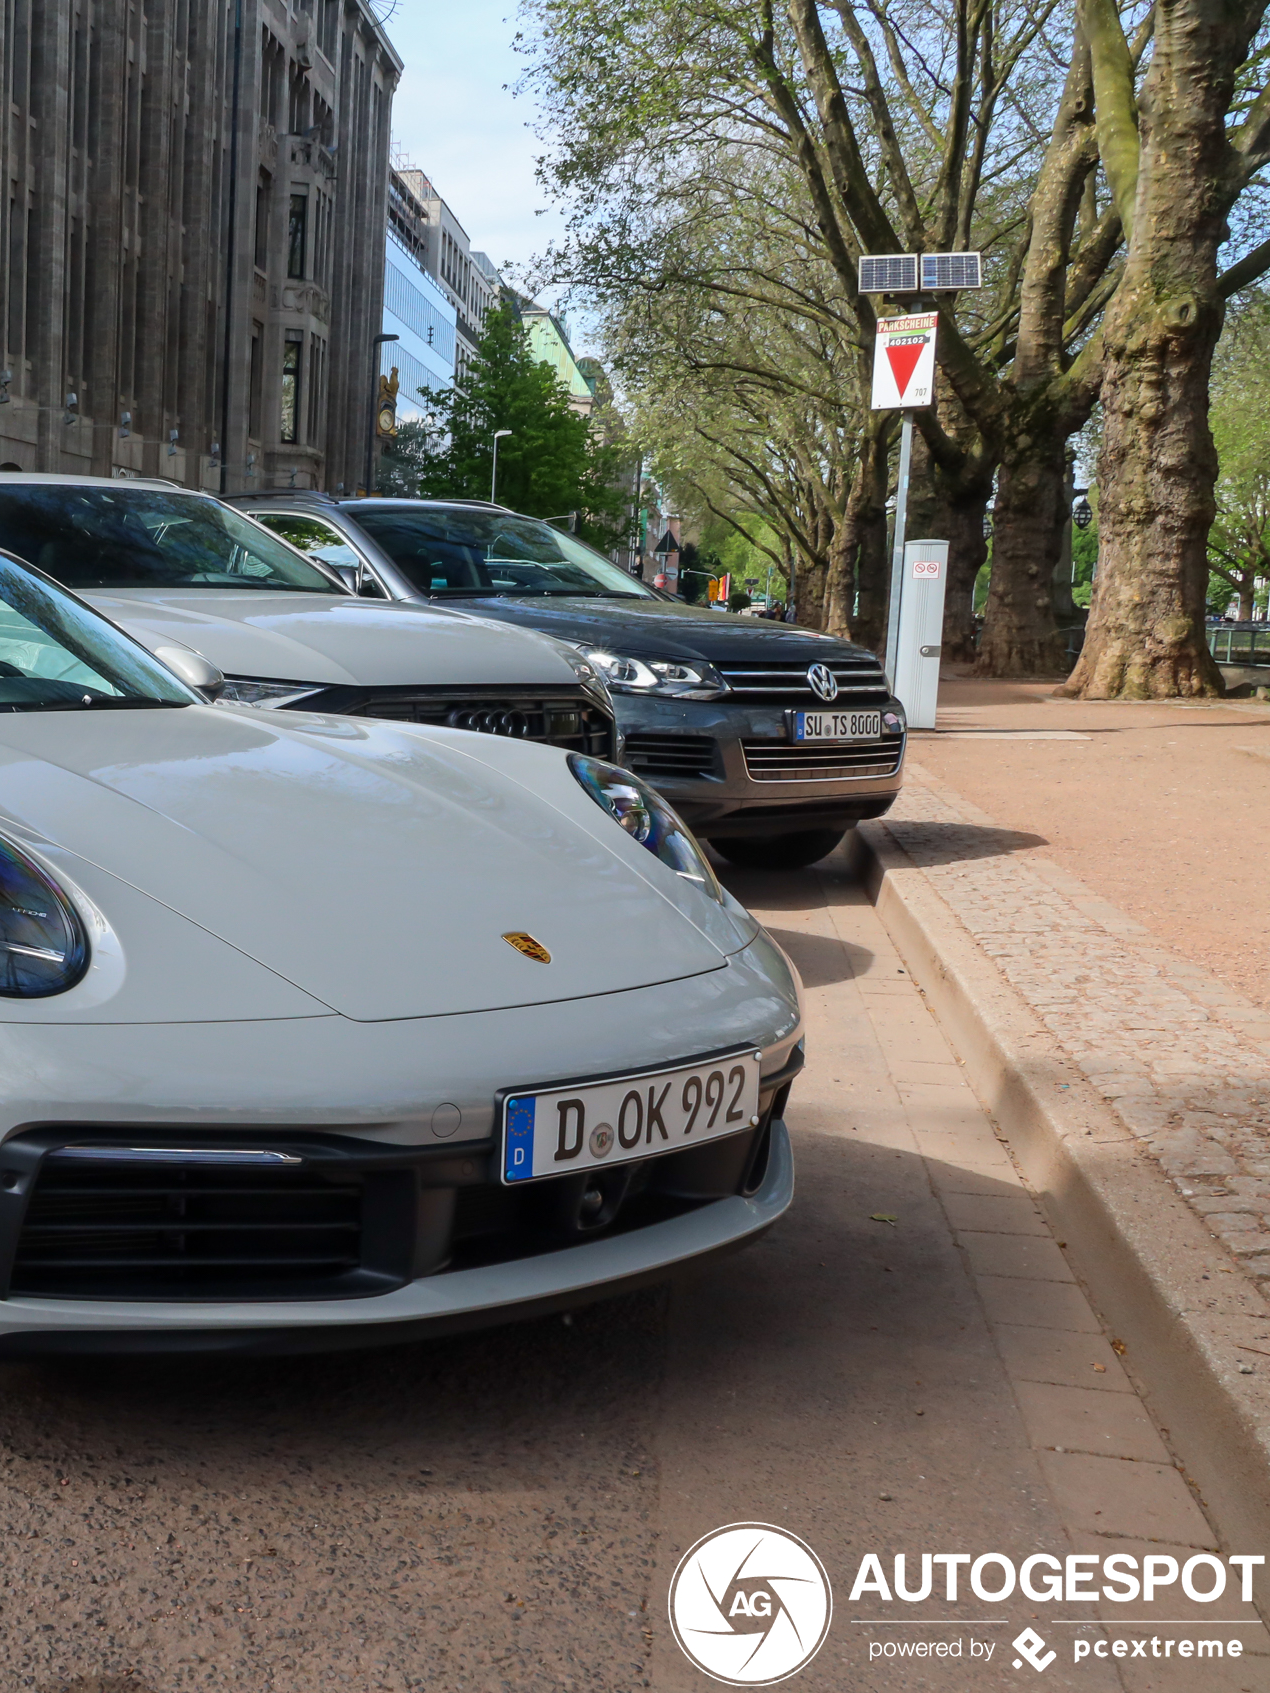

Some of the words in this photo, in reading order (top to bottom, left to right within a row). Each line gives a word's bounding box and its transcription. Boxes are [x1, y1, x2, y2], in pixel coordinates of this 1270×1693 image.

[878, 317, 935, 332] PARKSCHEINE
[889, 336, 924, 346] 402102
[915, 388, 927, 397] 707
[805, 715, 822, 736] SU
[832, 715, 847, 736] TS
[850, 714, 879, 735] 8000
[554, 1098, 586, 1162] D
[618, 1082, 672, 1150] OK
[682, 1065, 746, 1135] 992
[514, 1148, 525, 1166] D
